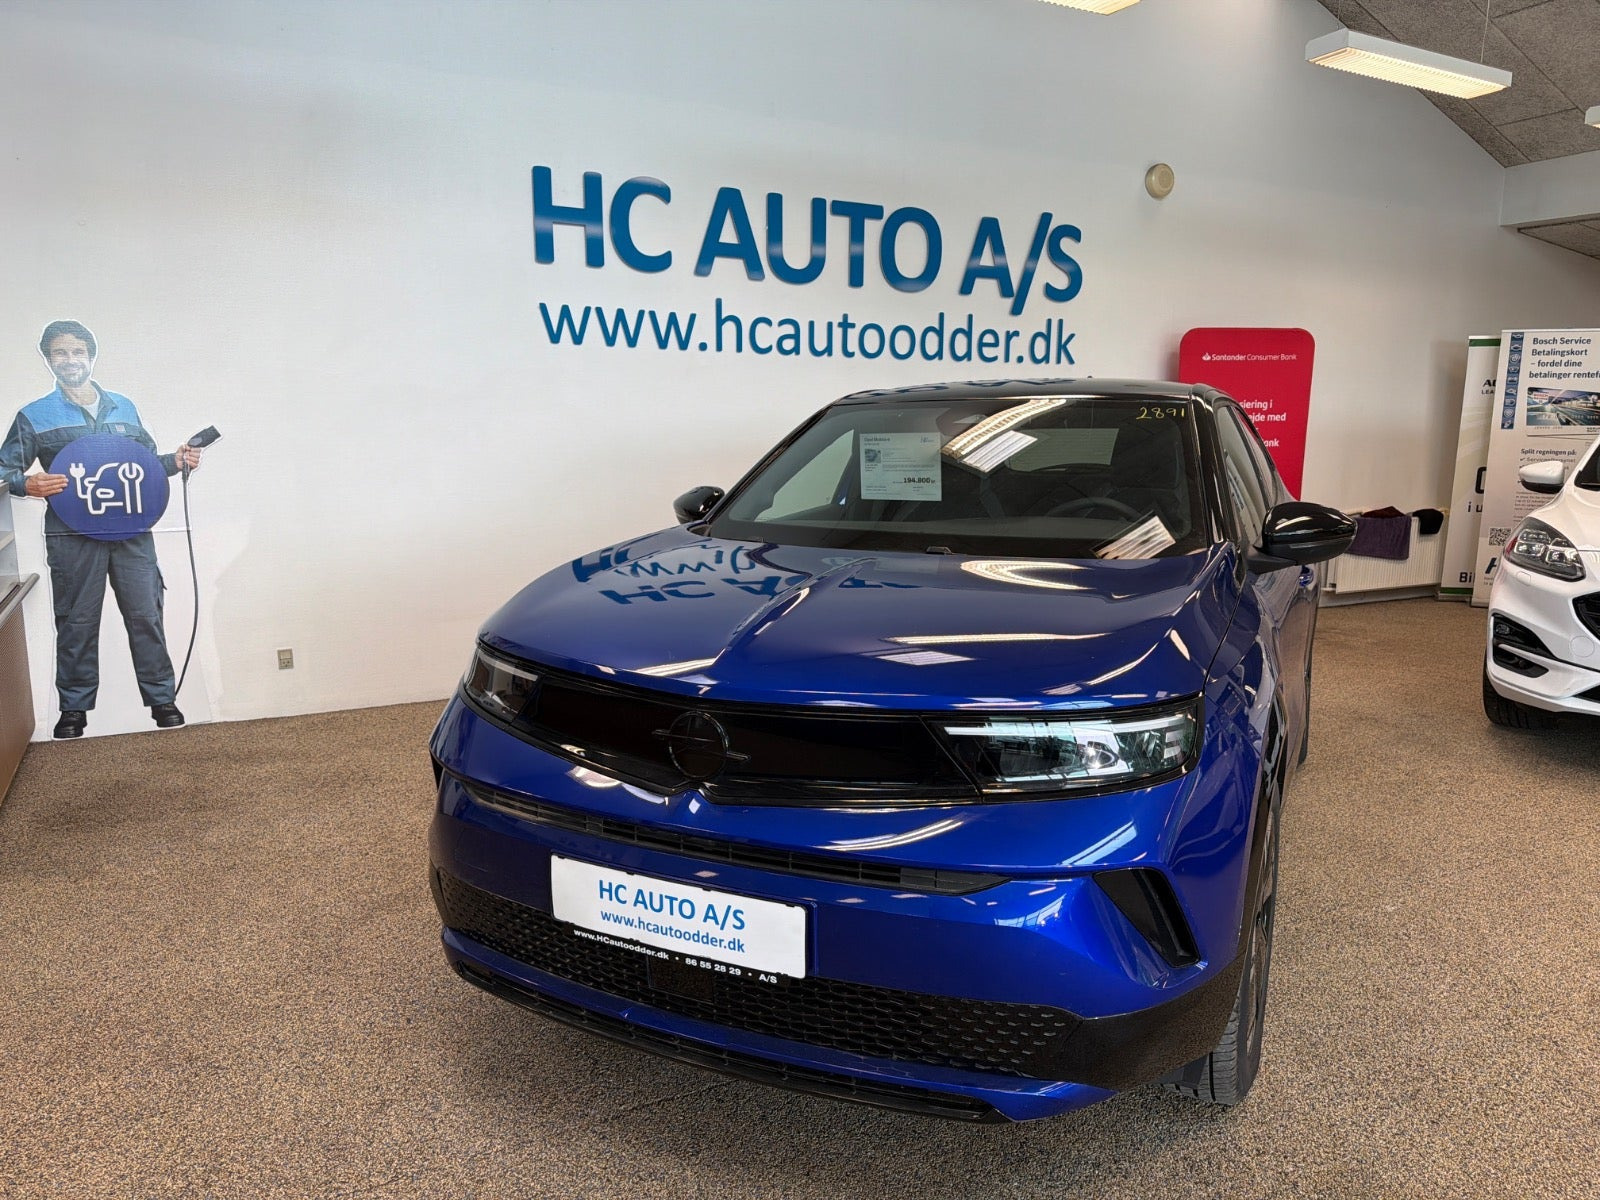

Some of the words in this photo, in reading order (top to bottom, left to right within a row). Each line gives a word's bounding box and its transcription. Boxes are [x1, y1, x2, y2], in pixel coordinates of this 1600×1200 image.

[531, 165, 672, 273] HC
[694, 187, 942, 293] AUTO
[959, 212, 1083, 315] A/S
[539, 298, 1076, 366] www.hcautoodder.dk
[1532, 337, 1558, 345] Bosch
[1559, 337, 1592, 345] Service
[1211, 353, 1247, 361] Santander
[1247, 353, 1280, 361] Consumer
[1280, 353, 1297, 361] Bank
[1531, 348, 1588, 358] Betalingskort
[1529, 371, 1571, 379] betalinger
[1239, 399, 1268, 411] siering
[1135, 406, 1185, 419] 2891
[1248, 413, 1266, 424] ejde
[1267, 412, 1287, 422] med
[1263, 439, 1280, 447] ank
[598, 880, 627, 905] HC
[633, 888, 696, 919] AUTO
[703, 904, 746, 931] A/S
[600, 910, 745, 953] www.hcautoodder.dk
[573, 929, 669, 960] www.HCautoodder.dk
[685, 957, 698, 967] 86
[699, 960, 712, 969] 55
[714, 963, 727, 973] 28
[728, 967, 742, 976] 29
[758, 973, 778, 984] A/S
